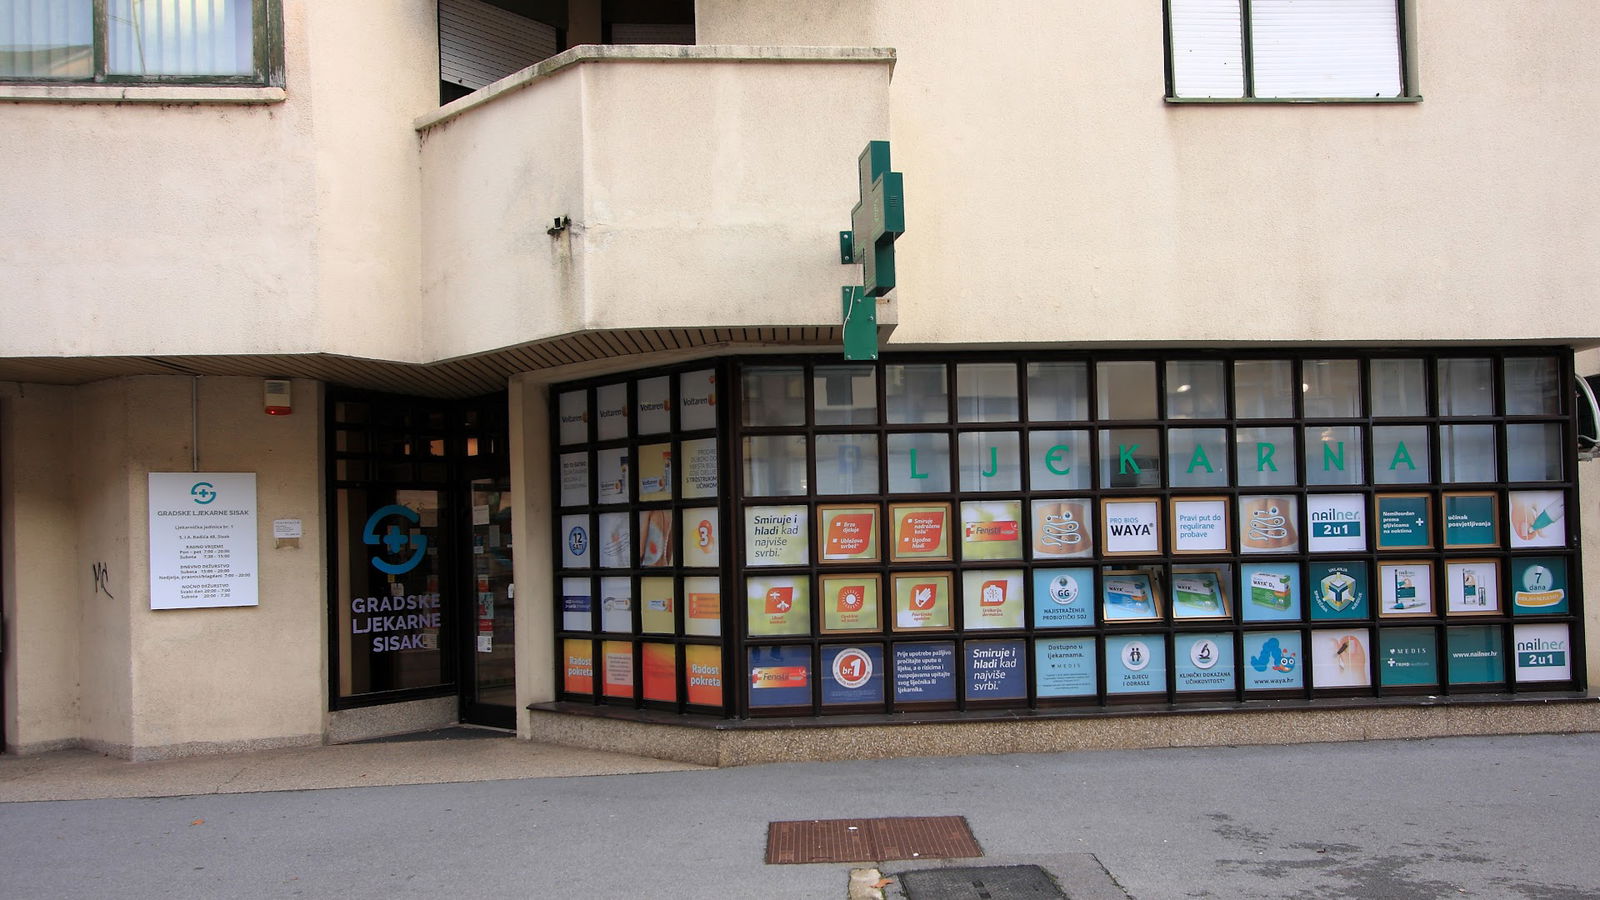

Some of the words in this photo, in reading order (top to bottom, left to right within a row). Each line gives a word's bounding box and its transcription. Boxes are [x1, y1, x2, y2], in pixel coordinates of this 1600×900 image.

[640, 402, 663, 411] Voltaren
[683, 397, 708, 406] Voltaren
[600, 410, 622, 418] Voltaren
[754, 515, 792, 525] Smiruje
[794, 514, 797, 524] i
[754, 526, 779, 535] hladi
[781, 525, 799, 535] kad
[573, 532, 582, 544] 12
[700, 526, 708, 546] 3
[755, 537, 787, 548] najviše
[1534, 573, 1542, 584] 7
[352, 593, 440, 613] GRADSKE
[352, 613, 441, 634] LJEKARNE
[373, 634, 424, 652] SISAK
[1518, 639, 1564, 651] nailner
[973, 648, 1010, 659] Smiruje
[1012, 648, 1016, 657] i
[1047, 652, 1084, 660] ljekarnama.
[570, 656, 592, 666] Radost
[973, 660, 997, 669] hladi
[1000, 659, 1016, 668] kad
[568, 667, 592, 677] pokreta
[692, 664, 719, 675] Radost
[842, 667, 852, 675] br.
[851, 659, 861, 677] 1
[974, 670, 1006, 681] najviše
[690, 676, 720, 687] pokreta
